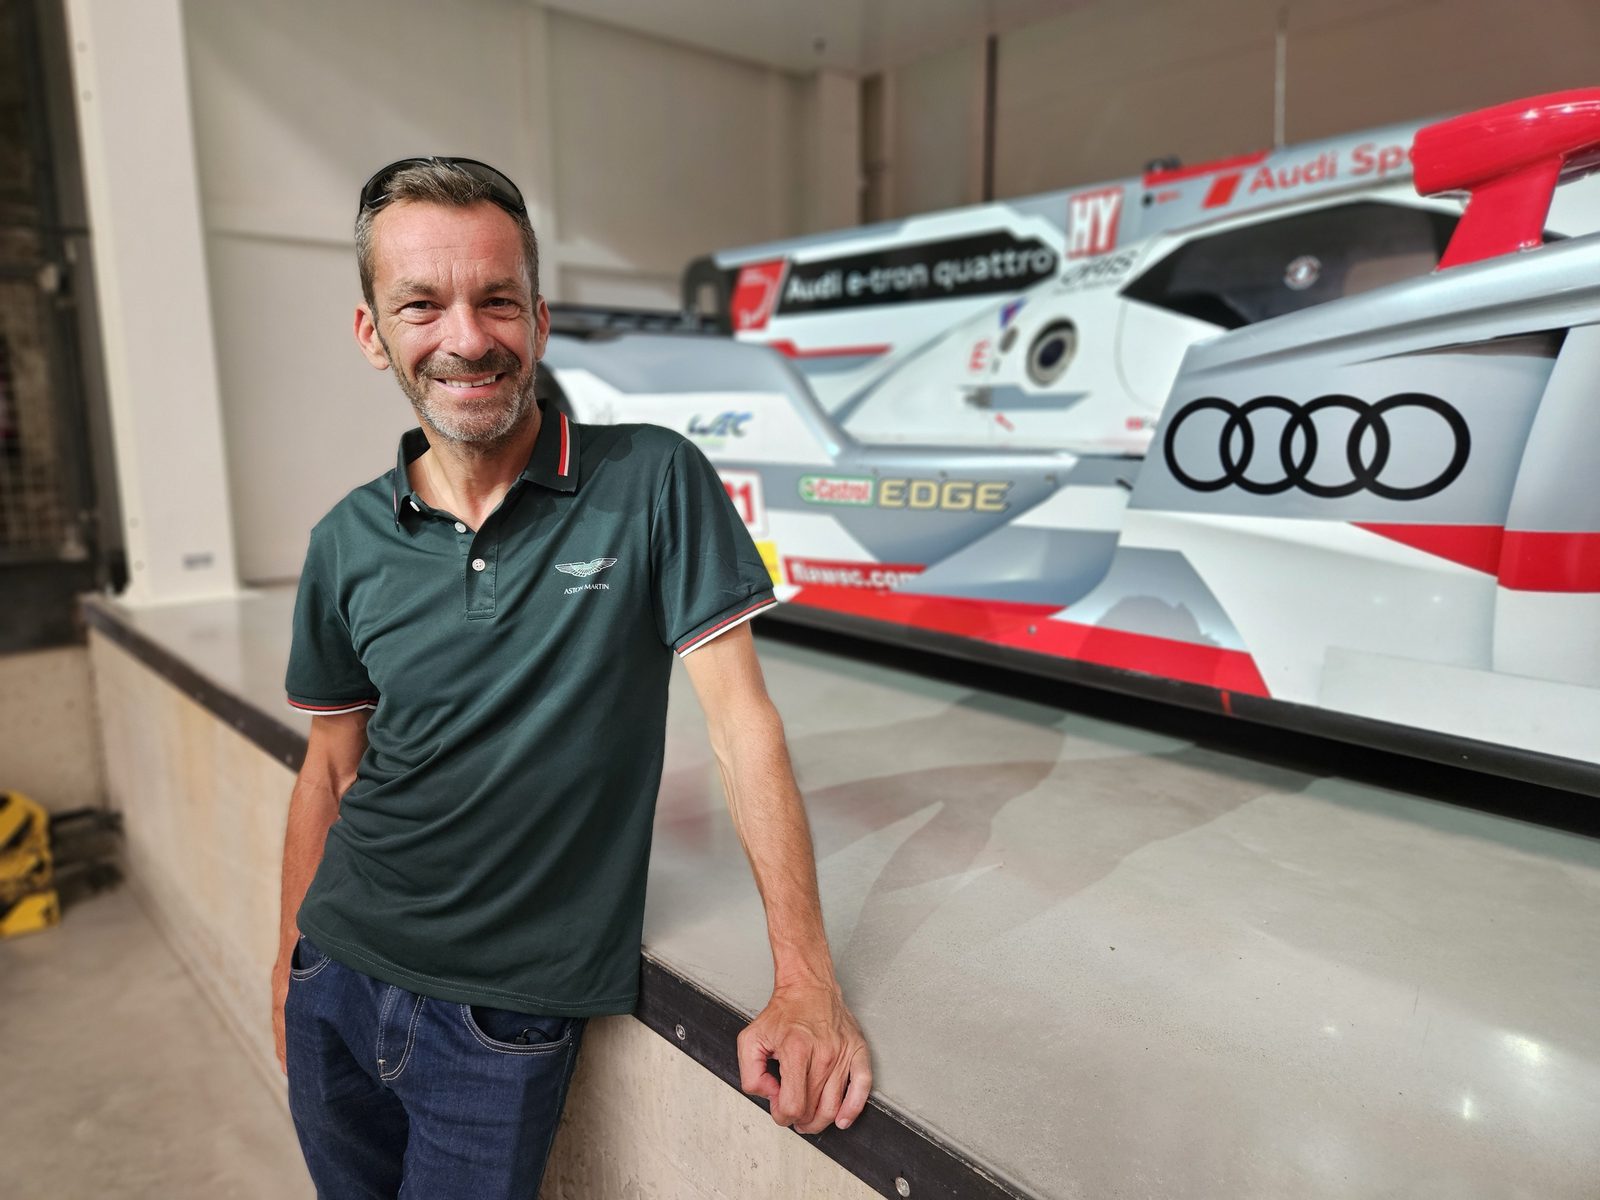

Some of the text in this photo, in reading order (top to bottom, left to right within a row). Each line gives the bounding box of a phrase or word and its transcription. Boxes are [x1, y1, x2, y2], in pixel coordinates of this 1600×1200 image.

[1249, 143, 1414, 194] Audi Sp
[1069, 191, 1122, 251] HY
[785, 269, 842, 302] Audi
[846, 262, 929, 297] e-tron
[932, 248, 1053, 291] quattro
[816, 478, 1011, 513] Castrol EDGE
[564, 585, 584, 595] ASTON
